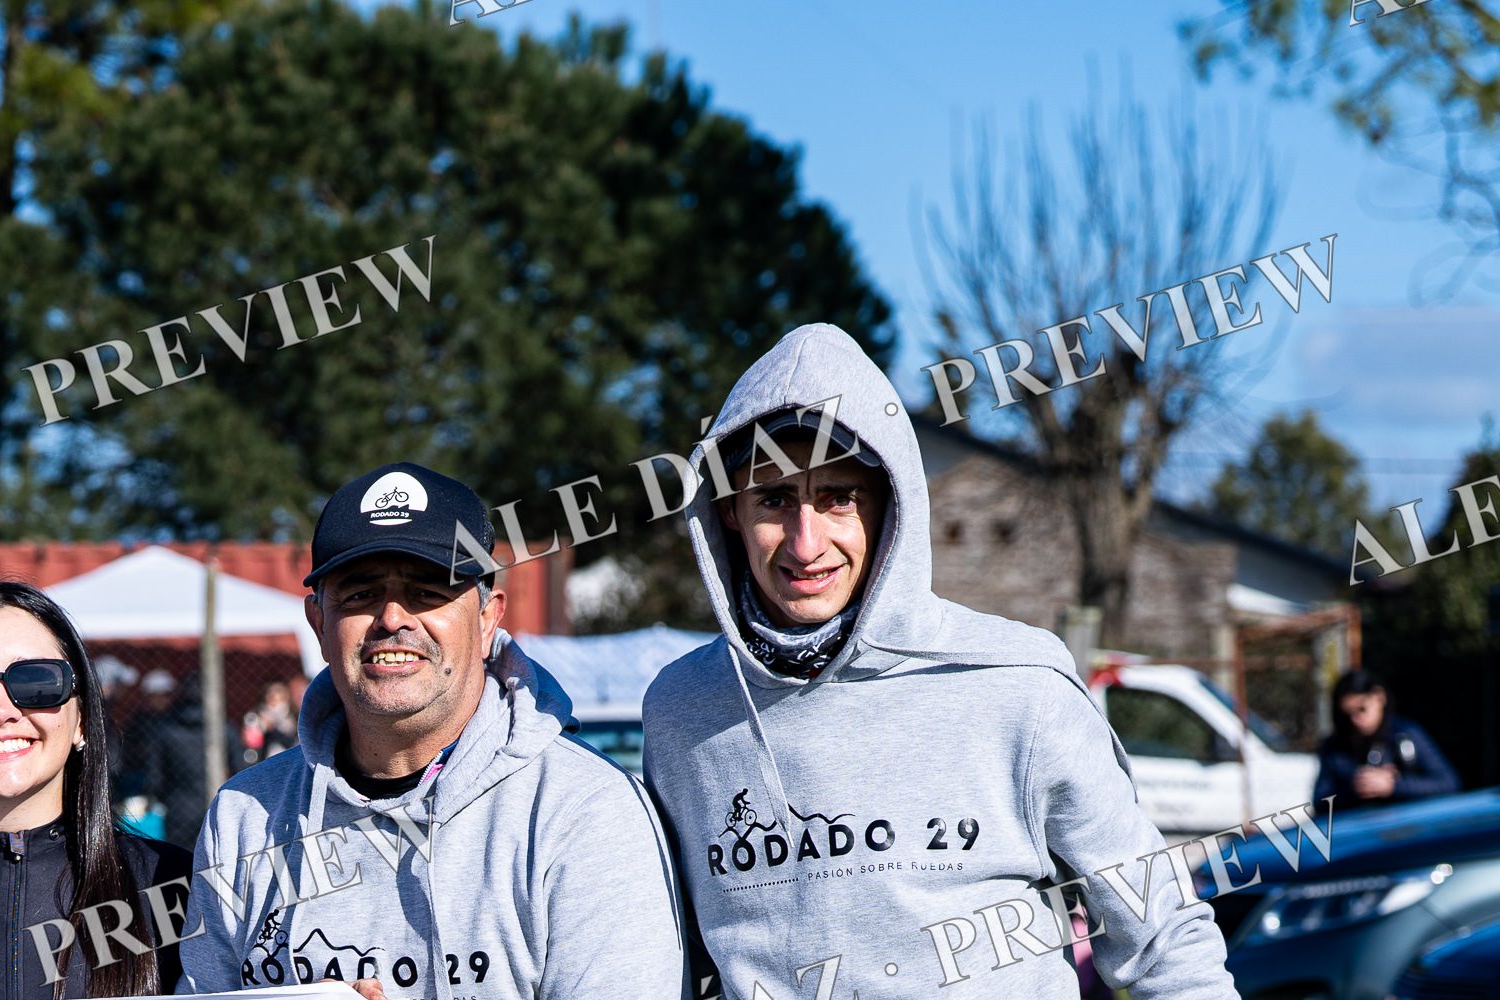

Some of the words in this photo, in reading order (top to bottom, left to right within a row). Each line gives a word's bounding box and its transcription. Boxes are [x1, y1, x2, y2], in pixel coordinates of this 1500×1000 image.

[370, 511, 400, 519] RODADO
[707, 819, 896, 877] RODADO
[926, 816, 980, 851] 29
[807, 866, 853, 881] PASIÓN
[860, 861, 903, 874] SOBRE
[911, 860, 964, 871] RUEDAS
[241, 956, 418, 987] RODADO
[445, 950, 490, 985] 29
